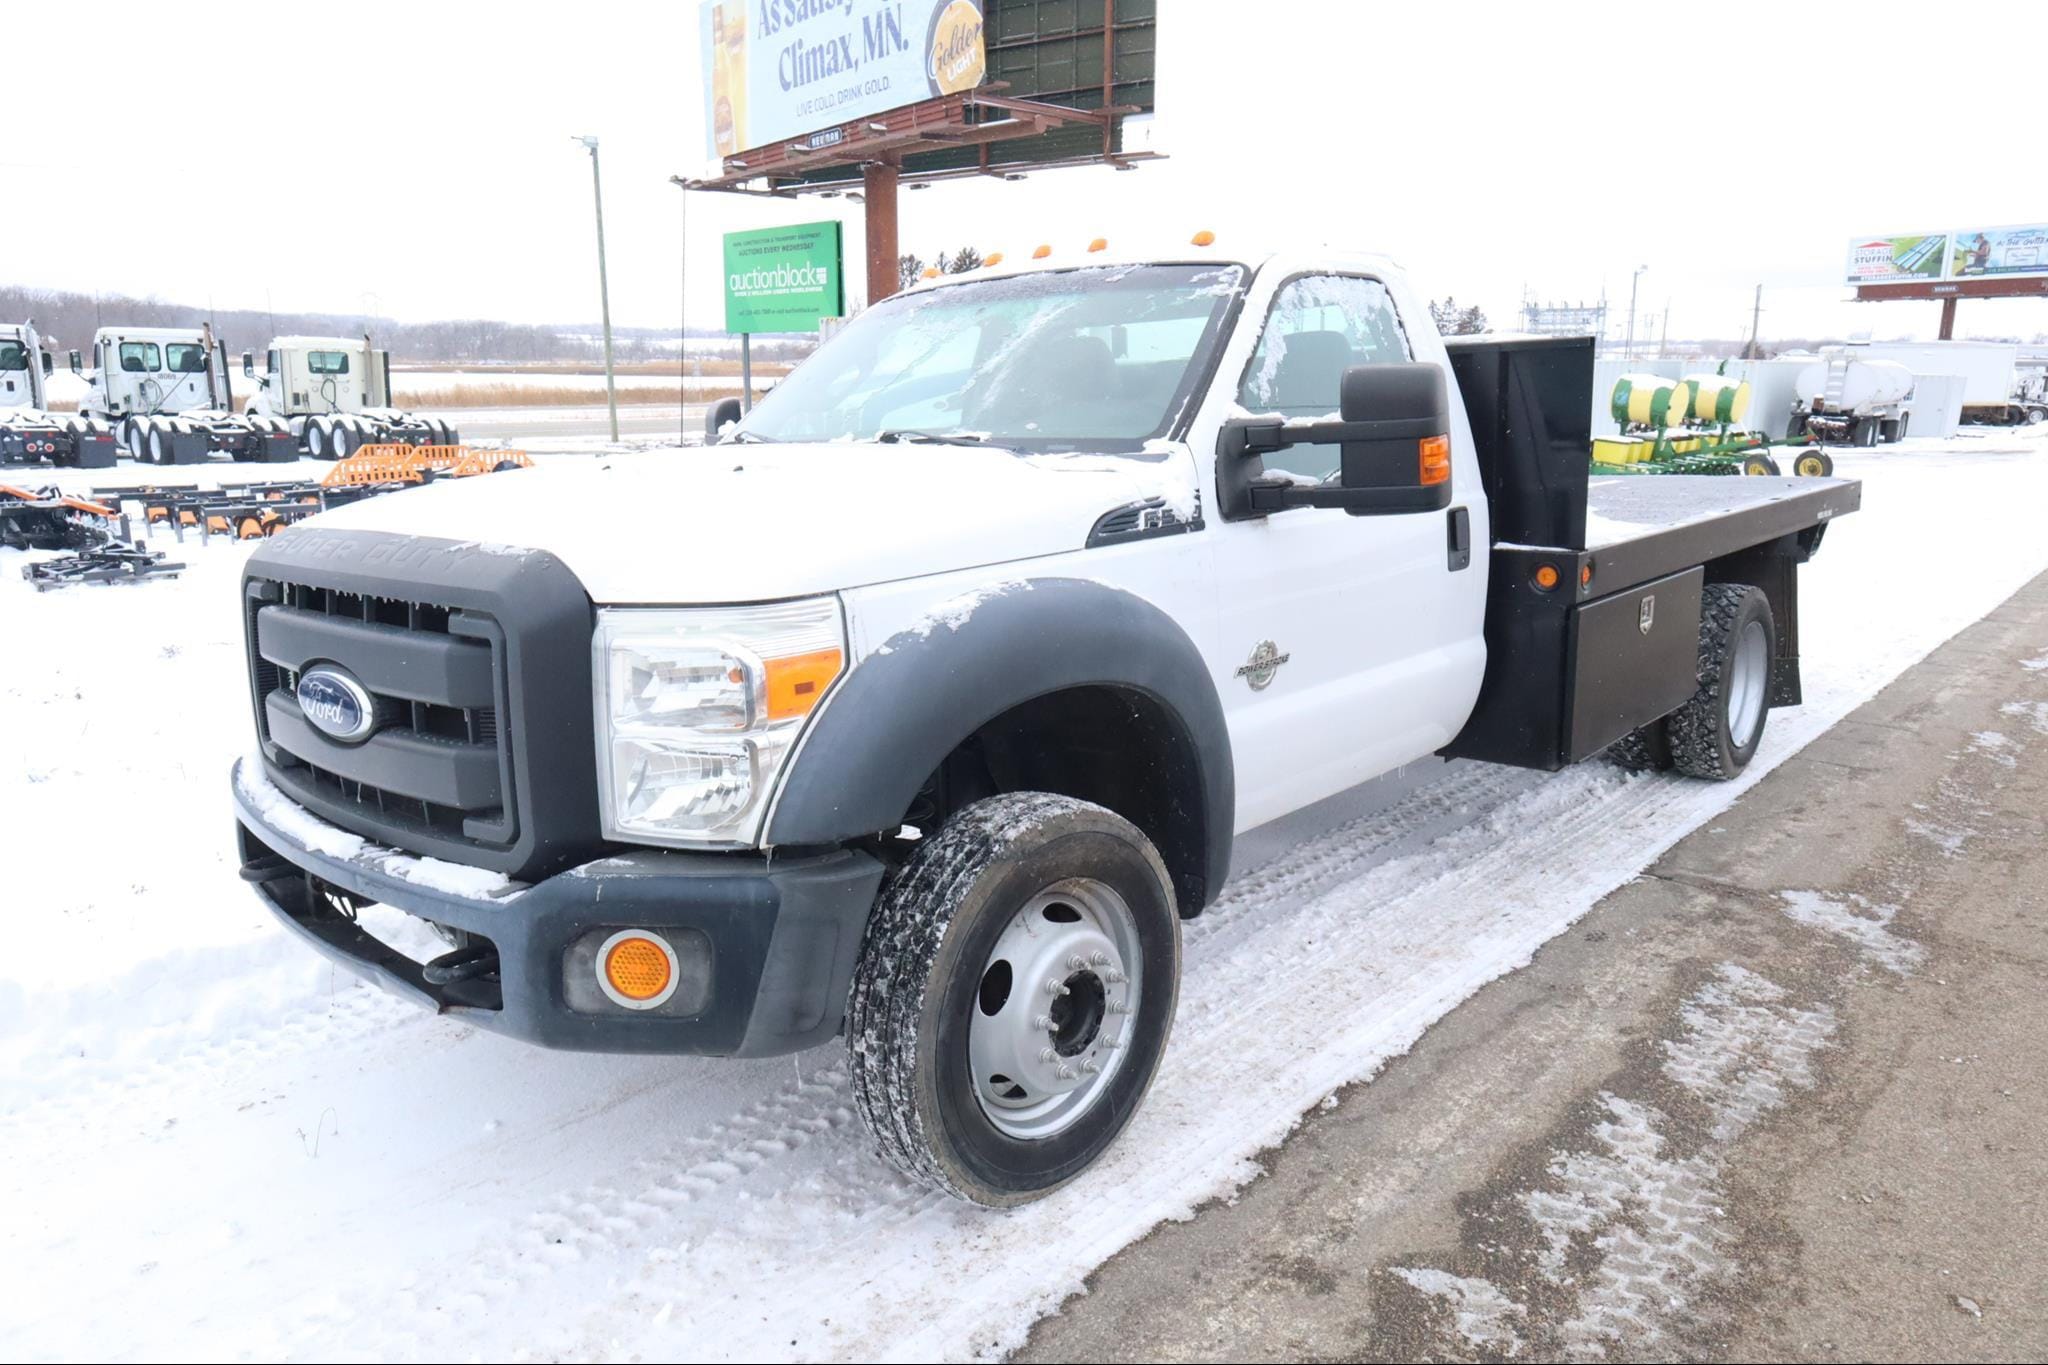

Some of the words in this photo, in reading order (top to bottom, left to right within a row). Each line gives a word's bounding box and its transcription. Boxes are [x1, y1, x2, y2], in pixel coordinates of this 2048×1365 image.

[779, 38, 859, 92] Climax,
[862, 3, 909, 64] MN.
[947, 47, 977, 82] LIGHT
[796, 100, 813, 117] LIVE
[837, 84, 862, 104] DRINK
[864, 76, 892, 95] GOLD.
[730, 260, 816, 291] auctionblock
[1854, 255, 1893, 264] STUFFIN
[272, 534, 358, 560] SUPER
[359, 537, 474, 571] DUTY
[306, 681, 344, 724] Ford
